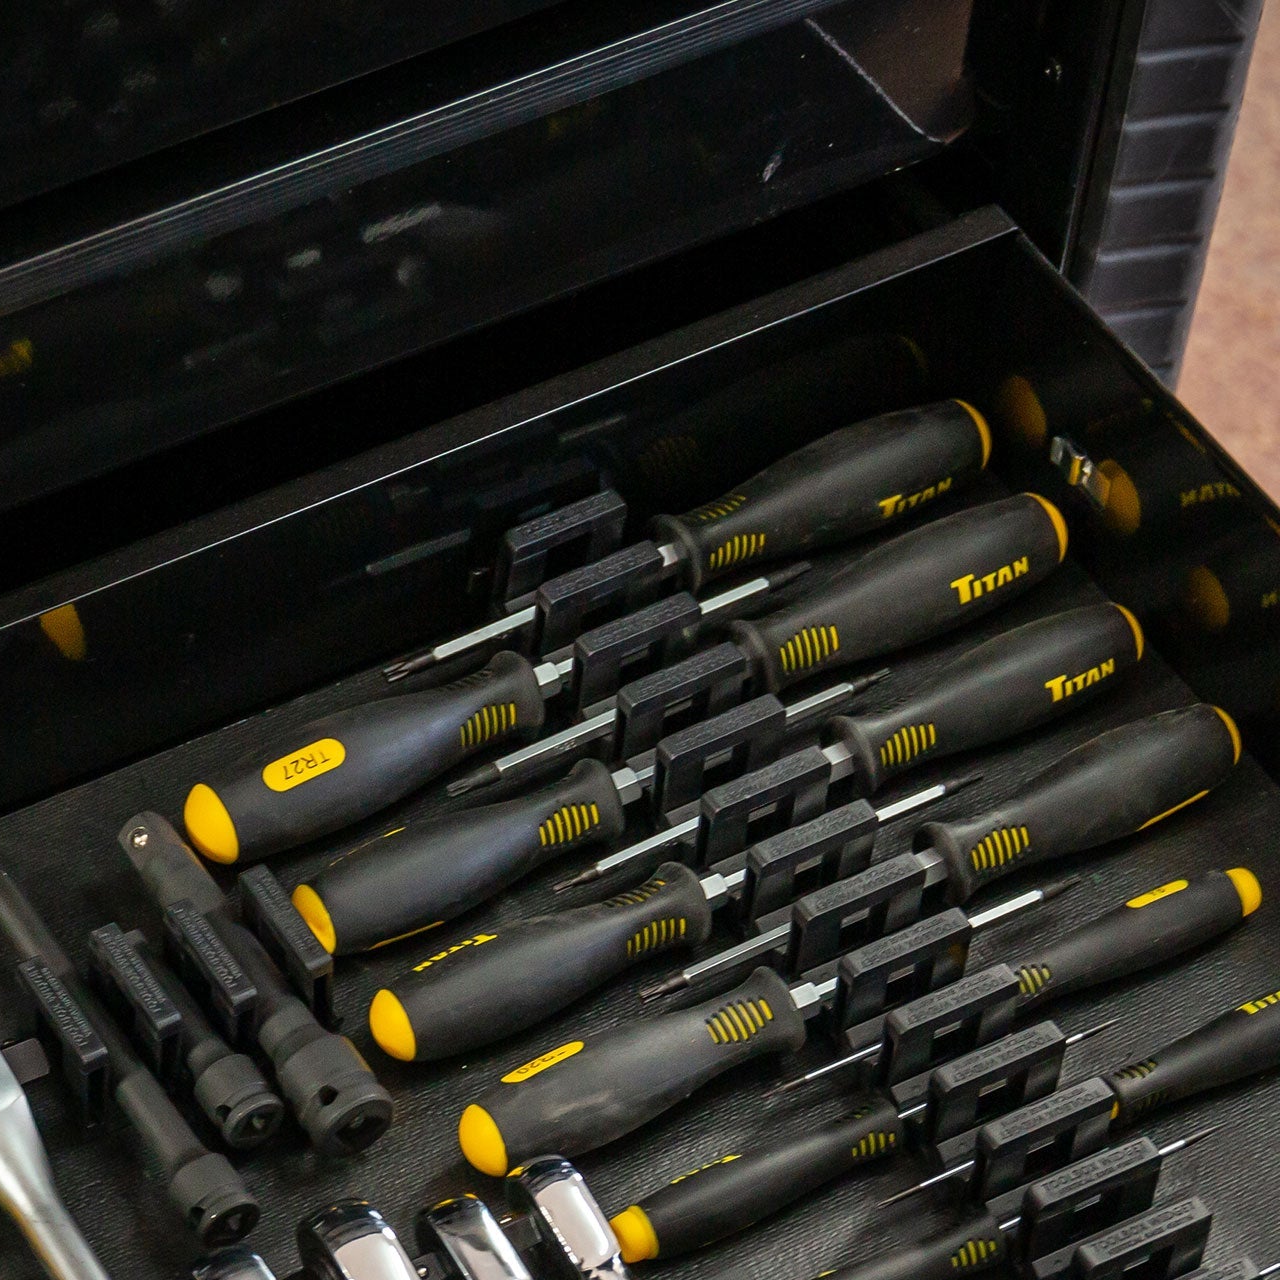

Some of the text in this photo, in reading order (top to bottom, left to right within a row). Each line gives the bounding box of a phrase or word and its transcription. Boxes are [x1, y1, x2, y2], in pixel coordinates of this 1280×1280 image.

[877, 478, 952, 517] TITAN
[949, 556, 1029, 604] TITAN
[1044, 658, 1115, 702] TITAN
[282, 750, 331, 780] TR27
